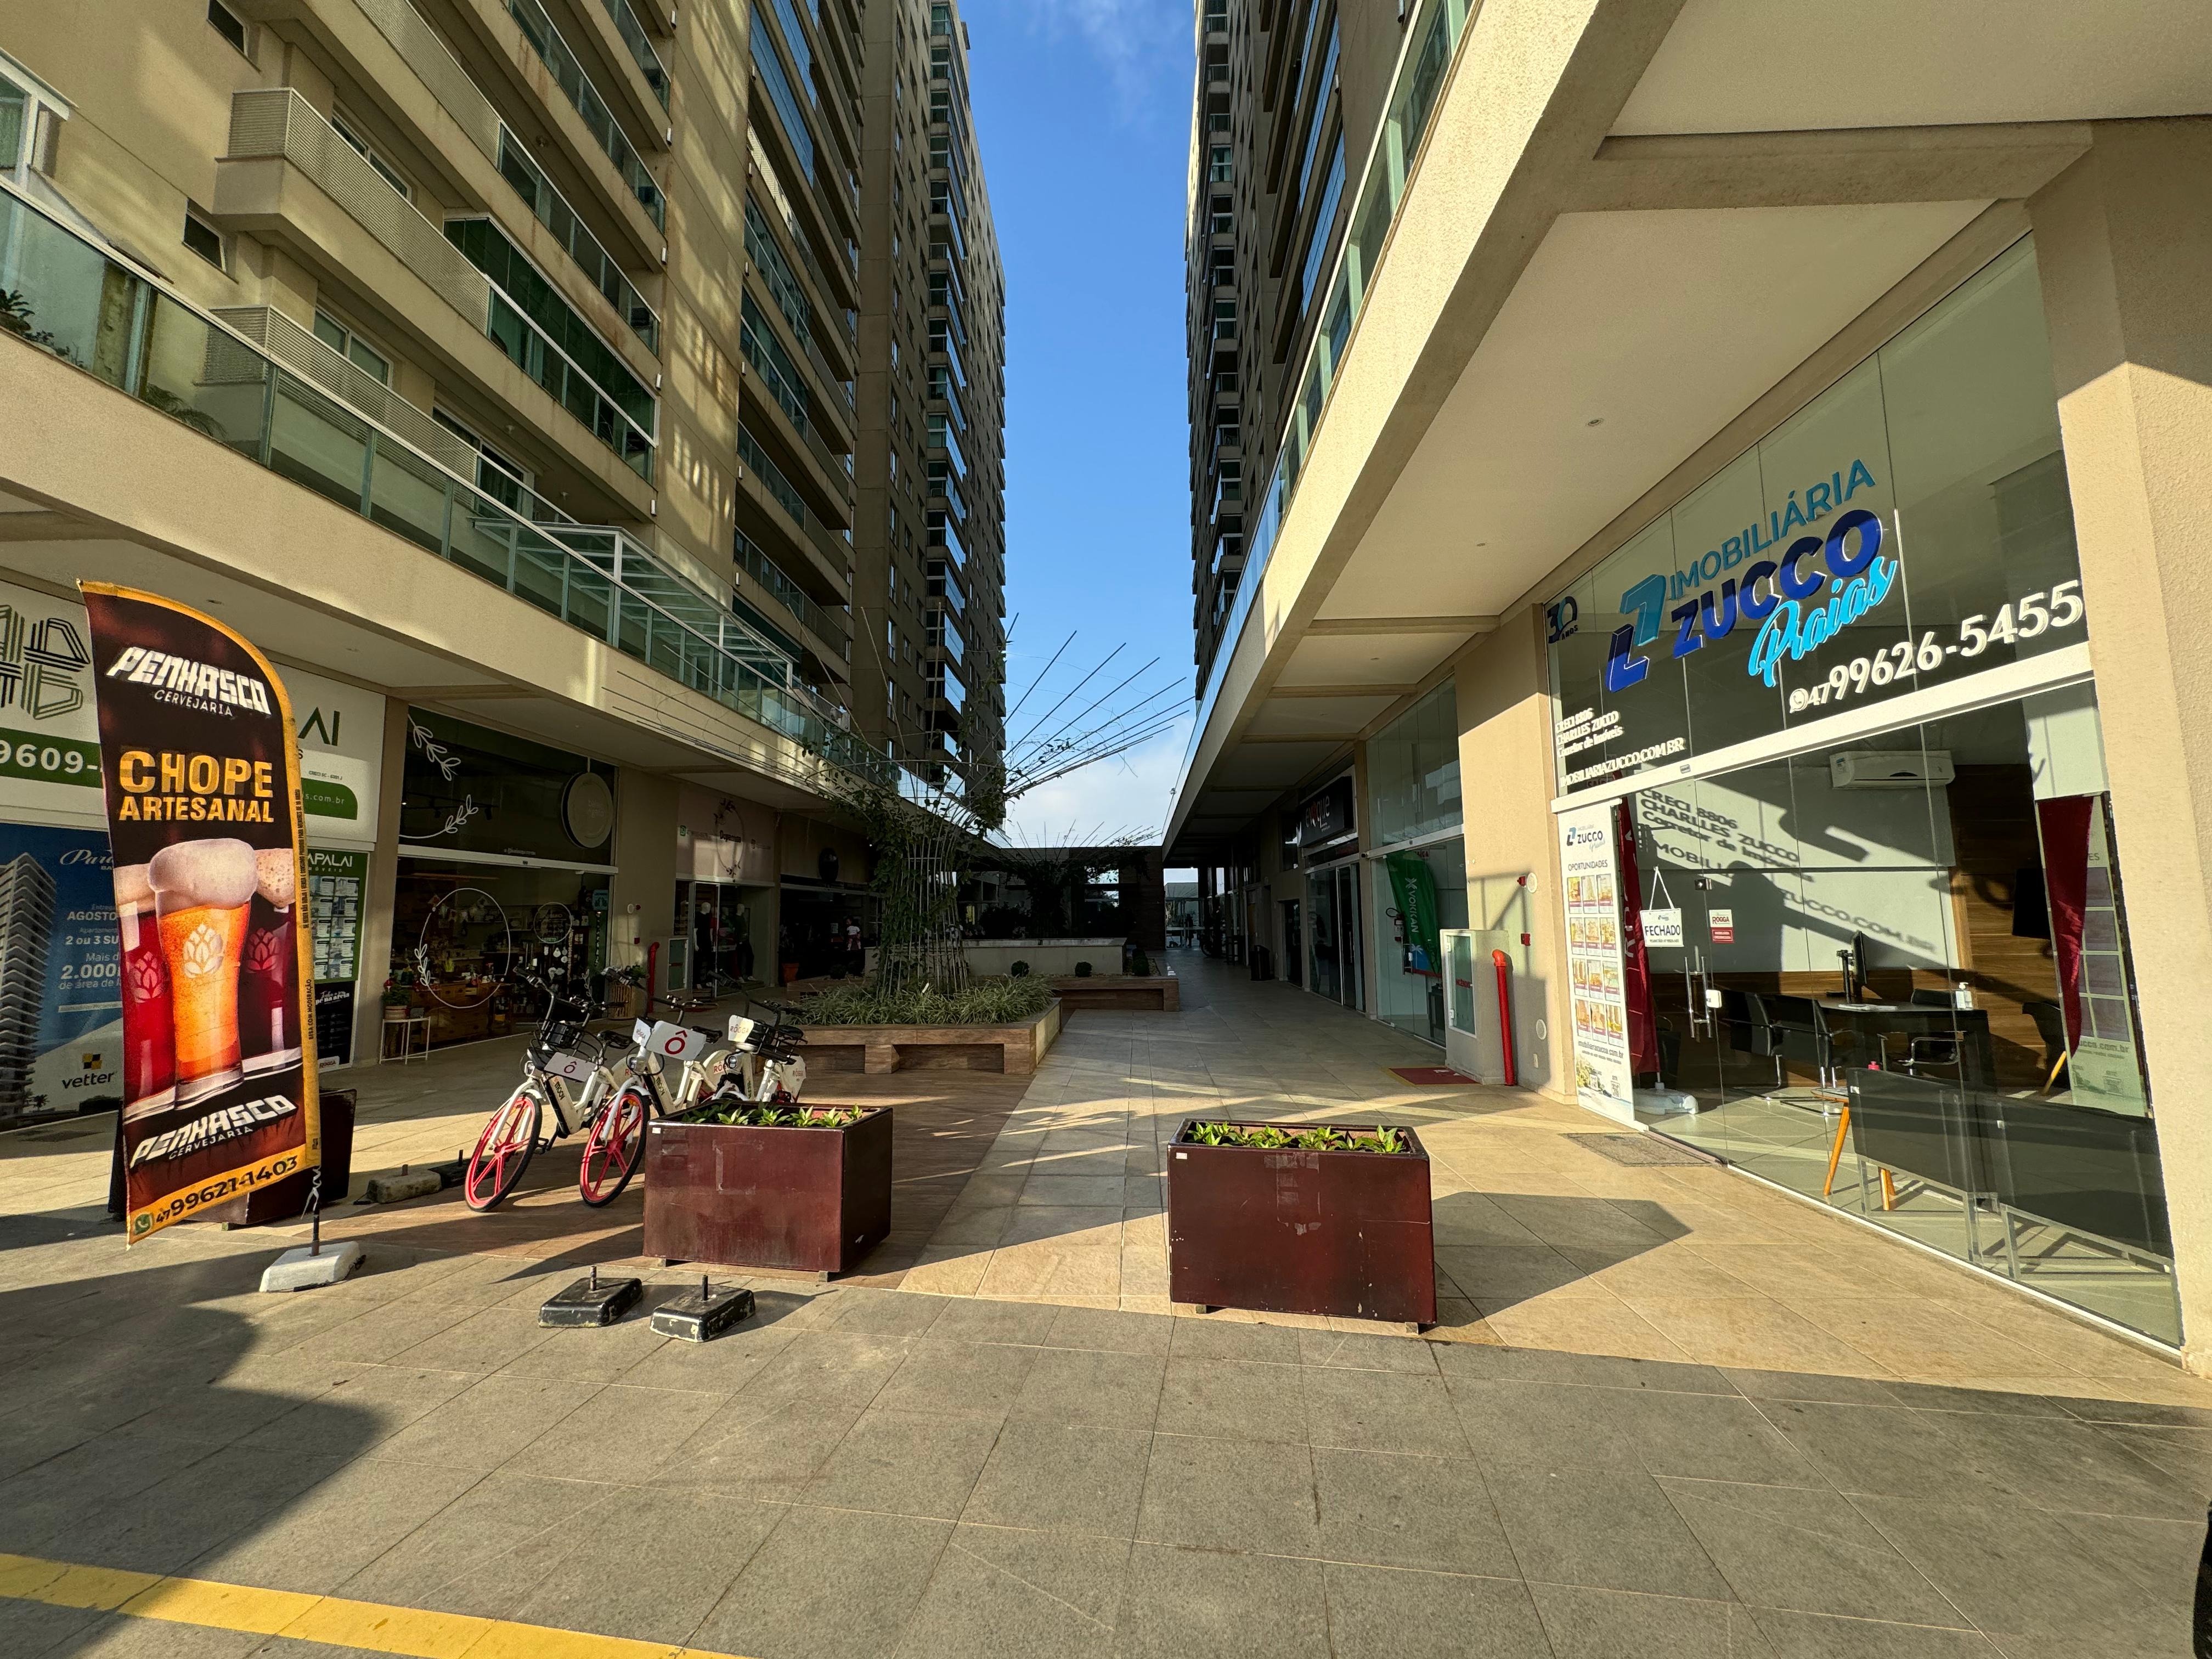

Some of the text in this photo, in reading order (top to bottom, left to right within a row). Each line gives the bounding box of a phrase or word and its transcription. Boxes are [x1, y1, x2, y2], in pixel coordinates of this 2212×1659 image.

[1670, 459, 1876, 600] IMOBILIÁRIA
[1671, 509, 1883, 659] ZUCCO
[1547, 596, 1577, 644] 30
[1748, 556, 1898, 688] Praias
[1561, 624, 1578, 640] ANOS
[1807, 579, 2084, 706] 47 99626-5455
[154, 689, 233, 717] CERVEJARIA
[1555, 718, 1575, 734] CRECI
[1592, 710, 1620, 733] ZUCCO
[119, 751, 273, 798] CHOPE
[119, 795, 274, 823] ARTESANAL
[1577, 831, 1603, 844] ZUCCO
[1568, 859, 1608, 871] OPORTUNIDADES
[67, 911, 117, 921] AGOSTO
[66, 935, 74, 945] 2
[93, 935, 101, 944] 3
[1644, 925, 1680, 936] FECHADO
[86, 952, 110, 962] Mais
[60, 962, 120, 980] 2.000
[58, 980, 72, 990] de
[101, 978, 114, 988] de
[61, 1071, 115, 1089] vetter
[168, 1126, 253, 1160] CERVEJARIA
[156, 1155, 298, 1223] 47 99621-1403
